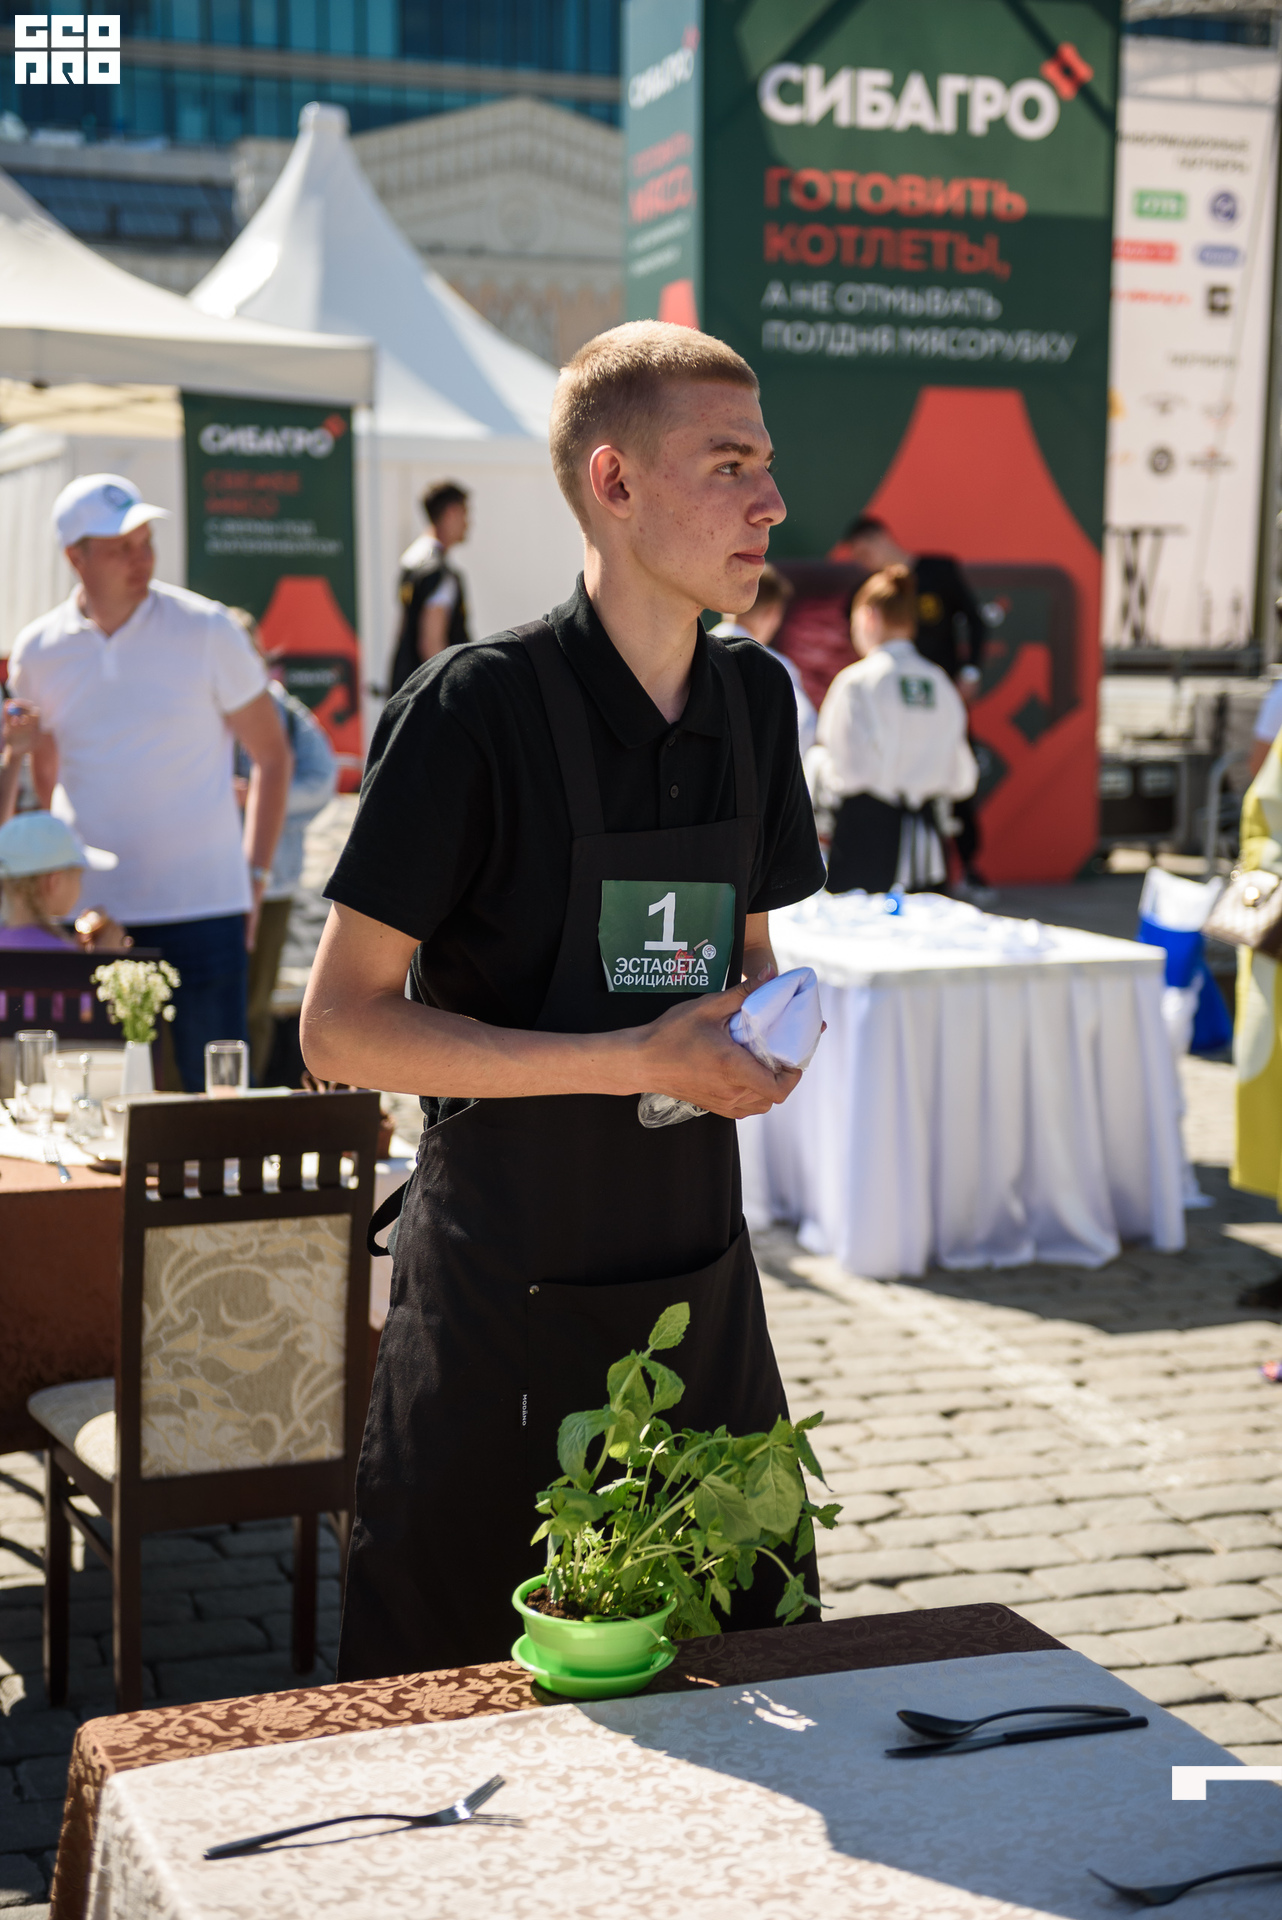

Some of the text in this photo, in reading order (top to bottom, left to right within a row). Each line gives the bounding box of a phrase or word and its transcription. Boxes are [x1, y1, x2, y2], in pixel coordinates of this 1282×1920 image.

[757, 60, 1061, 141] СИБАГРО
[763, 166, 1028, 222] ГОТОВИТЬ
[762, 221, 1012, 283] КОТЛЕТЫ,
[789, 280, 835, 317] НЕ
[834, 282, 1003, 322] ОТМЫВАТЬ
[761, 319, 1077, 364] ПОЛДНЯ МЯСОРУБКУ
[198, 423, 335, 459] СИБАГРО
[644, 892, 688, 951] 1
[613, 974, 709, 988] ОФИЦИАНТОВ
[615, 957, 708, 974] ЭСТАФЕТА
